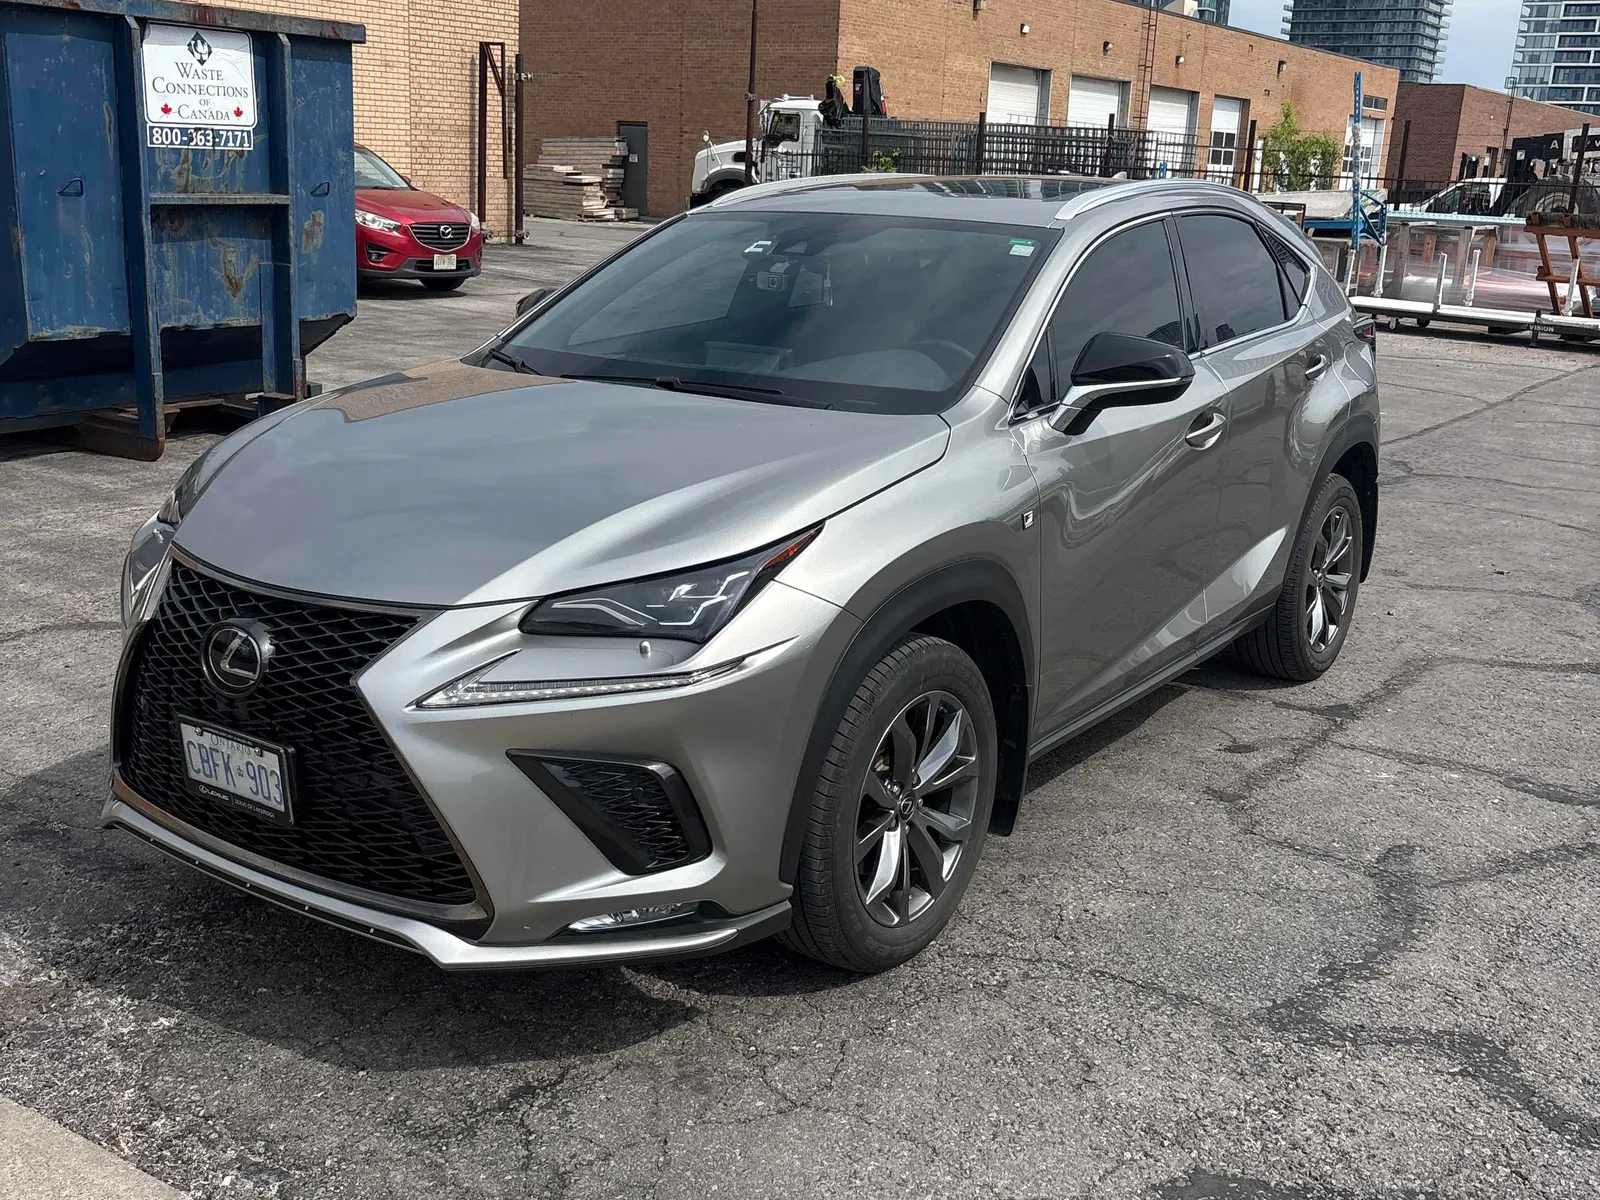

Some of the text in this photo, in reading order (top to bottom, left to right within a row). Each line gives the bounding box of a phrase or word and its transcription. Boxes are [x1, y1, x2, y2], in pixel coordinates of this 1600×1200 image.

[152, 77, 249, 98] CONNECTIONS
[177, 104, 231, 121] CANADA
[152, 127, 250, 147] 800-363-7171
[245, 760, 283, 805] 903
